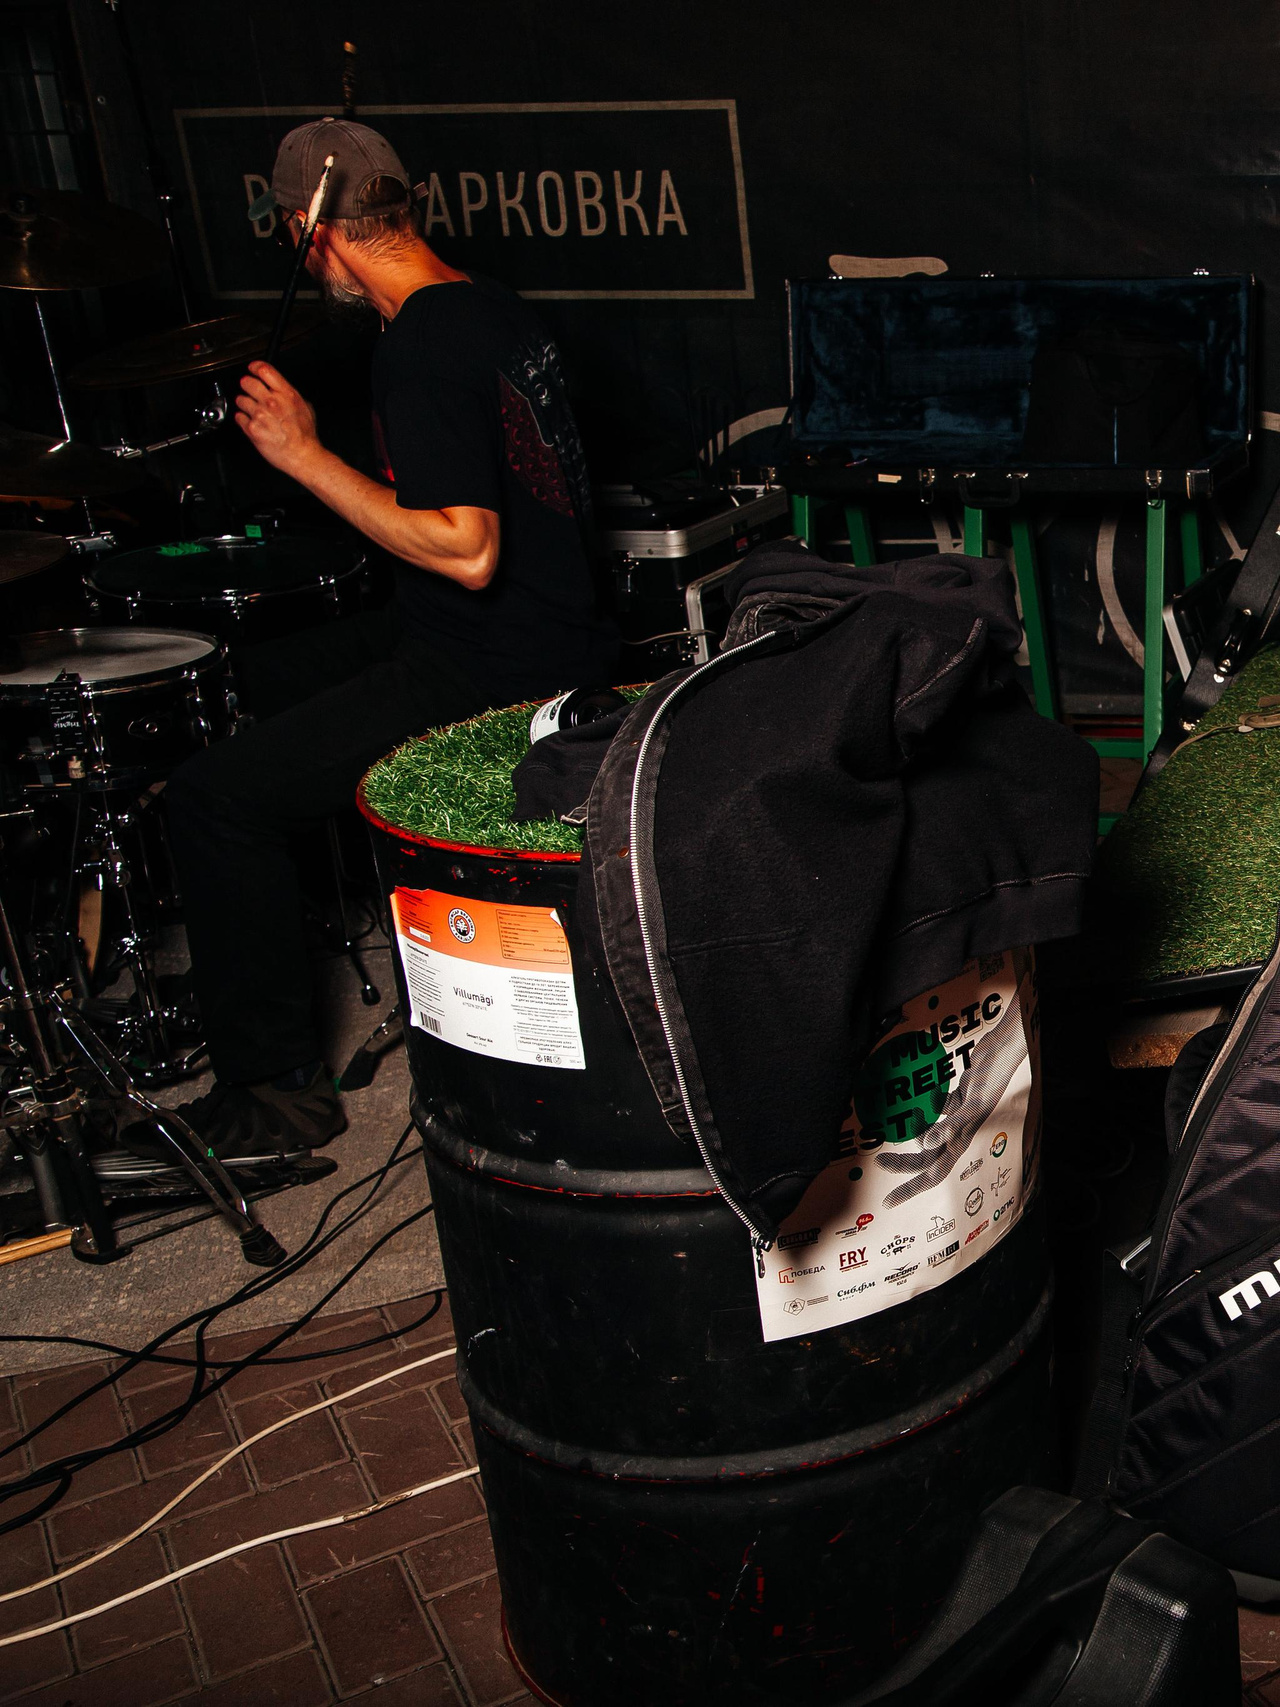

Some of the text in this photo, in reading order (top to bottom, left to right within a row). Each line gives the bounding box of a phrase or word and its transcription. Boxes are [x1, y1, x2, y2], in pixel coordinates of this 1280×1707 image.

[243, 169, 688, 239] ВАРКОВКА
[453, 986, 494, 1006] Villumägi
[888, 992, 1002, 1067] MUSIC
[842, 1040, 975, 1118] TREET
[834, 1108, 914, 1158] EST
[880, 1235, 916, 1255] CHOPS
[839, 1246, 867, 1267] FRY
[791, 1265, 826, 1278] ПОБЕДА
[884, 1264, 919, 1282] RECORD
